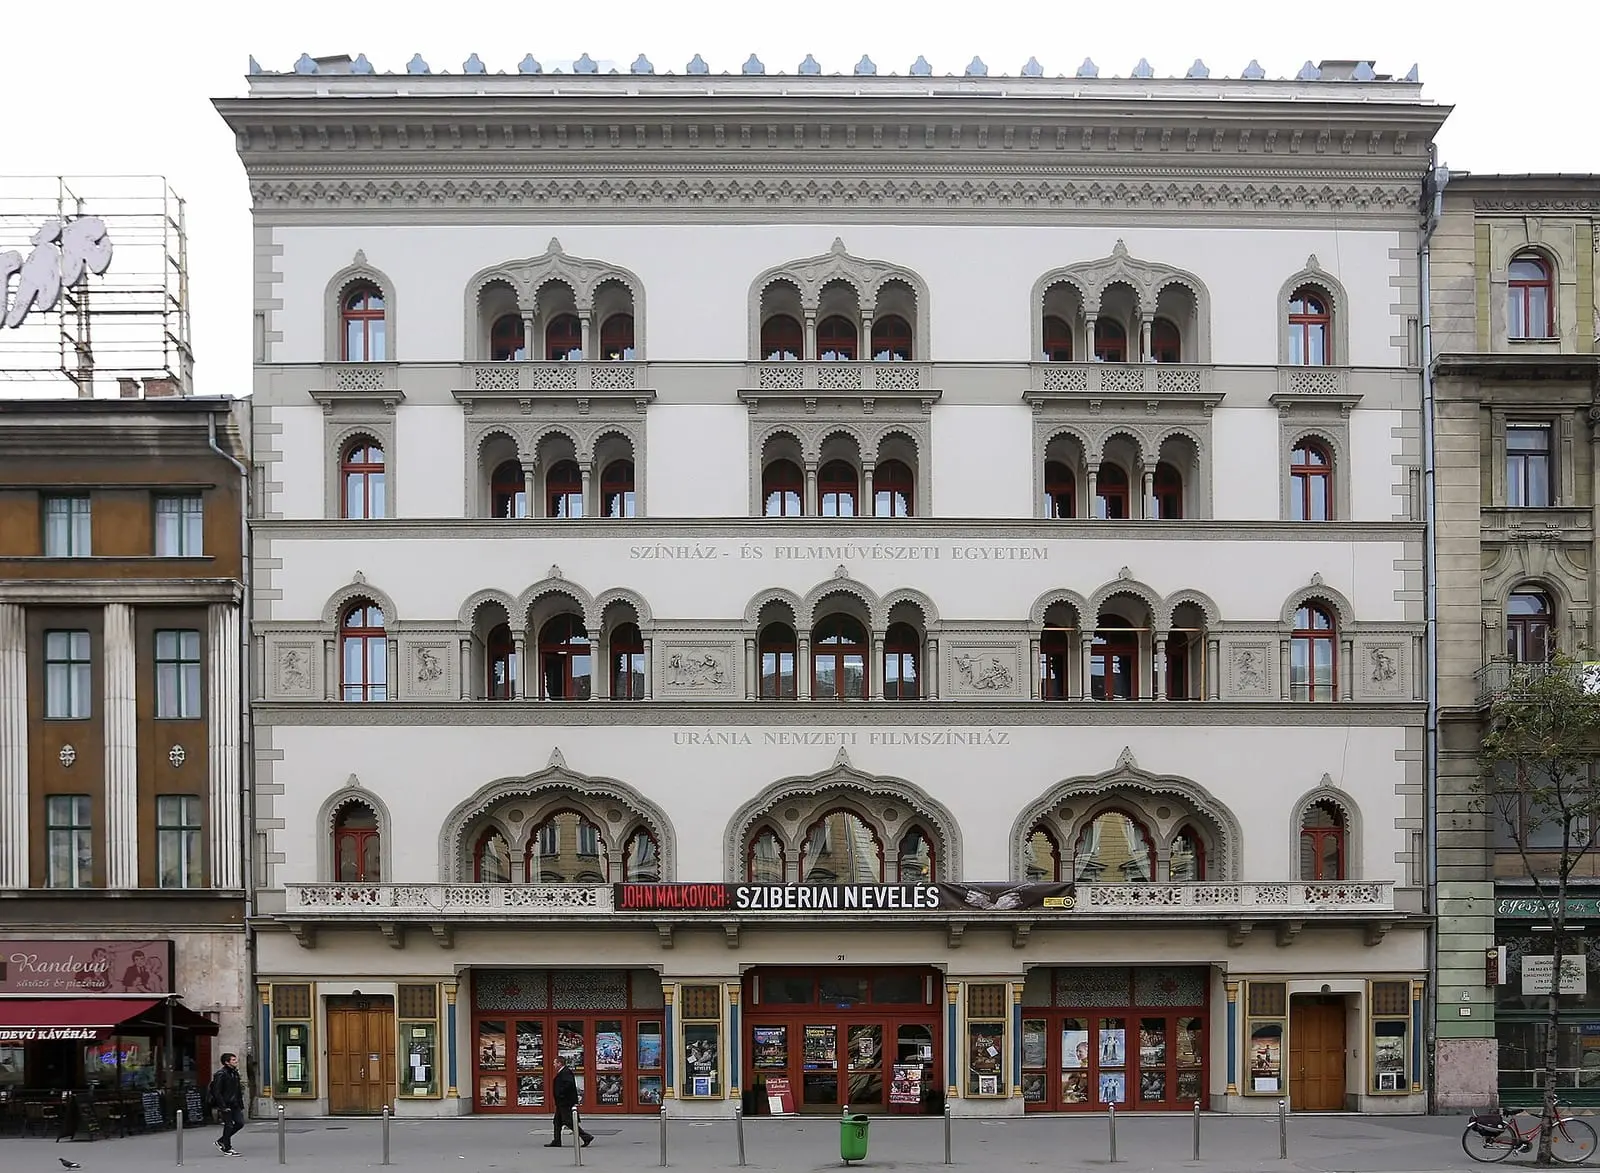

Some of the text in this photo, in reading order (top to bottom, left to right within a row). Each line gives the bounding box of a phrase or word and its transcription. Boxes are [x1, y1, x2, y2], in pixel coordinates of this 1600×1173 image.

[629, 544, 718, 560] SZÍNHÁZ
[740, 544, 763, 560] ÉS
[774, 543, 940, 560] FILMMŰVÉSZETI
[951, 546, 1049, 560] EGYETEM
[672, 730, 1010, 746] URÁNIA NEMZETI FILMSZÍNHÁZ
[621, 881, 940, 909] JOHN MALKOVICH: SZIBÉRIAI NEVELÉS
[10, 953, 109, 973] Randevú
[37, 1027, 97, 1040] KÁVÉHÁZ
